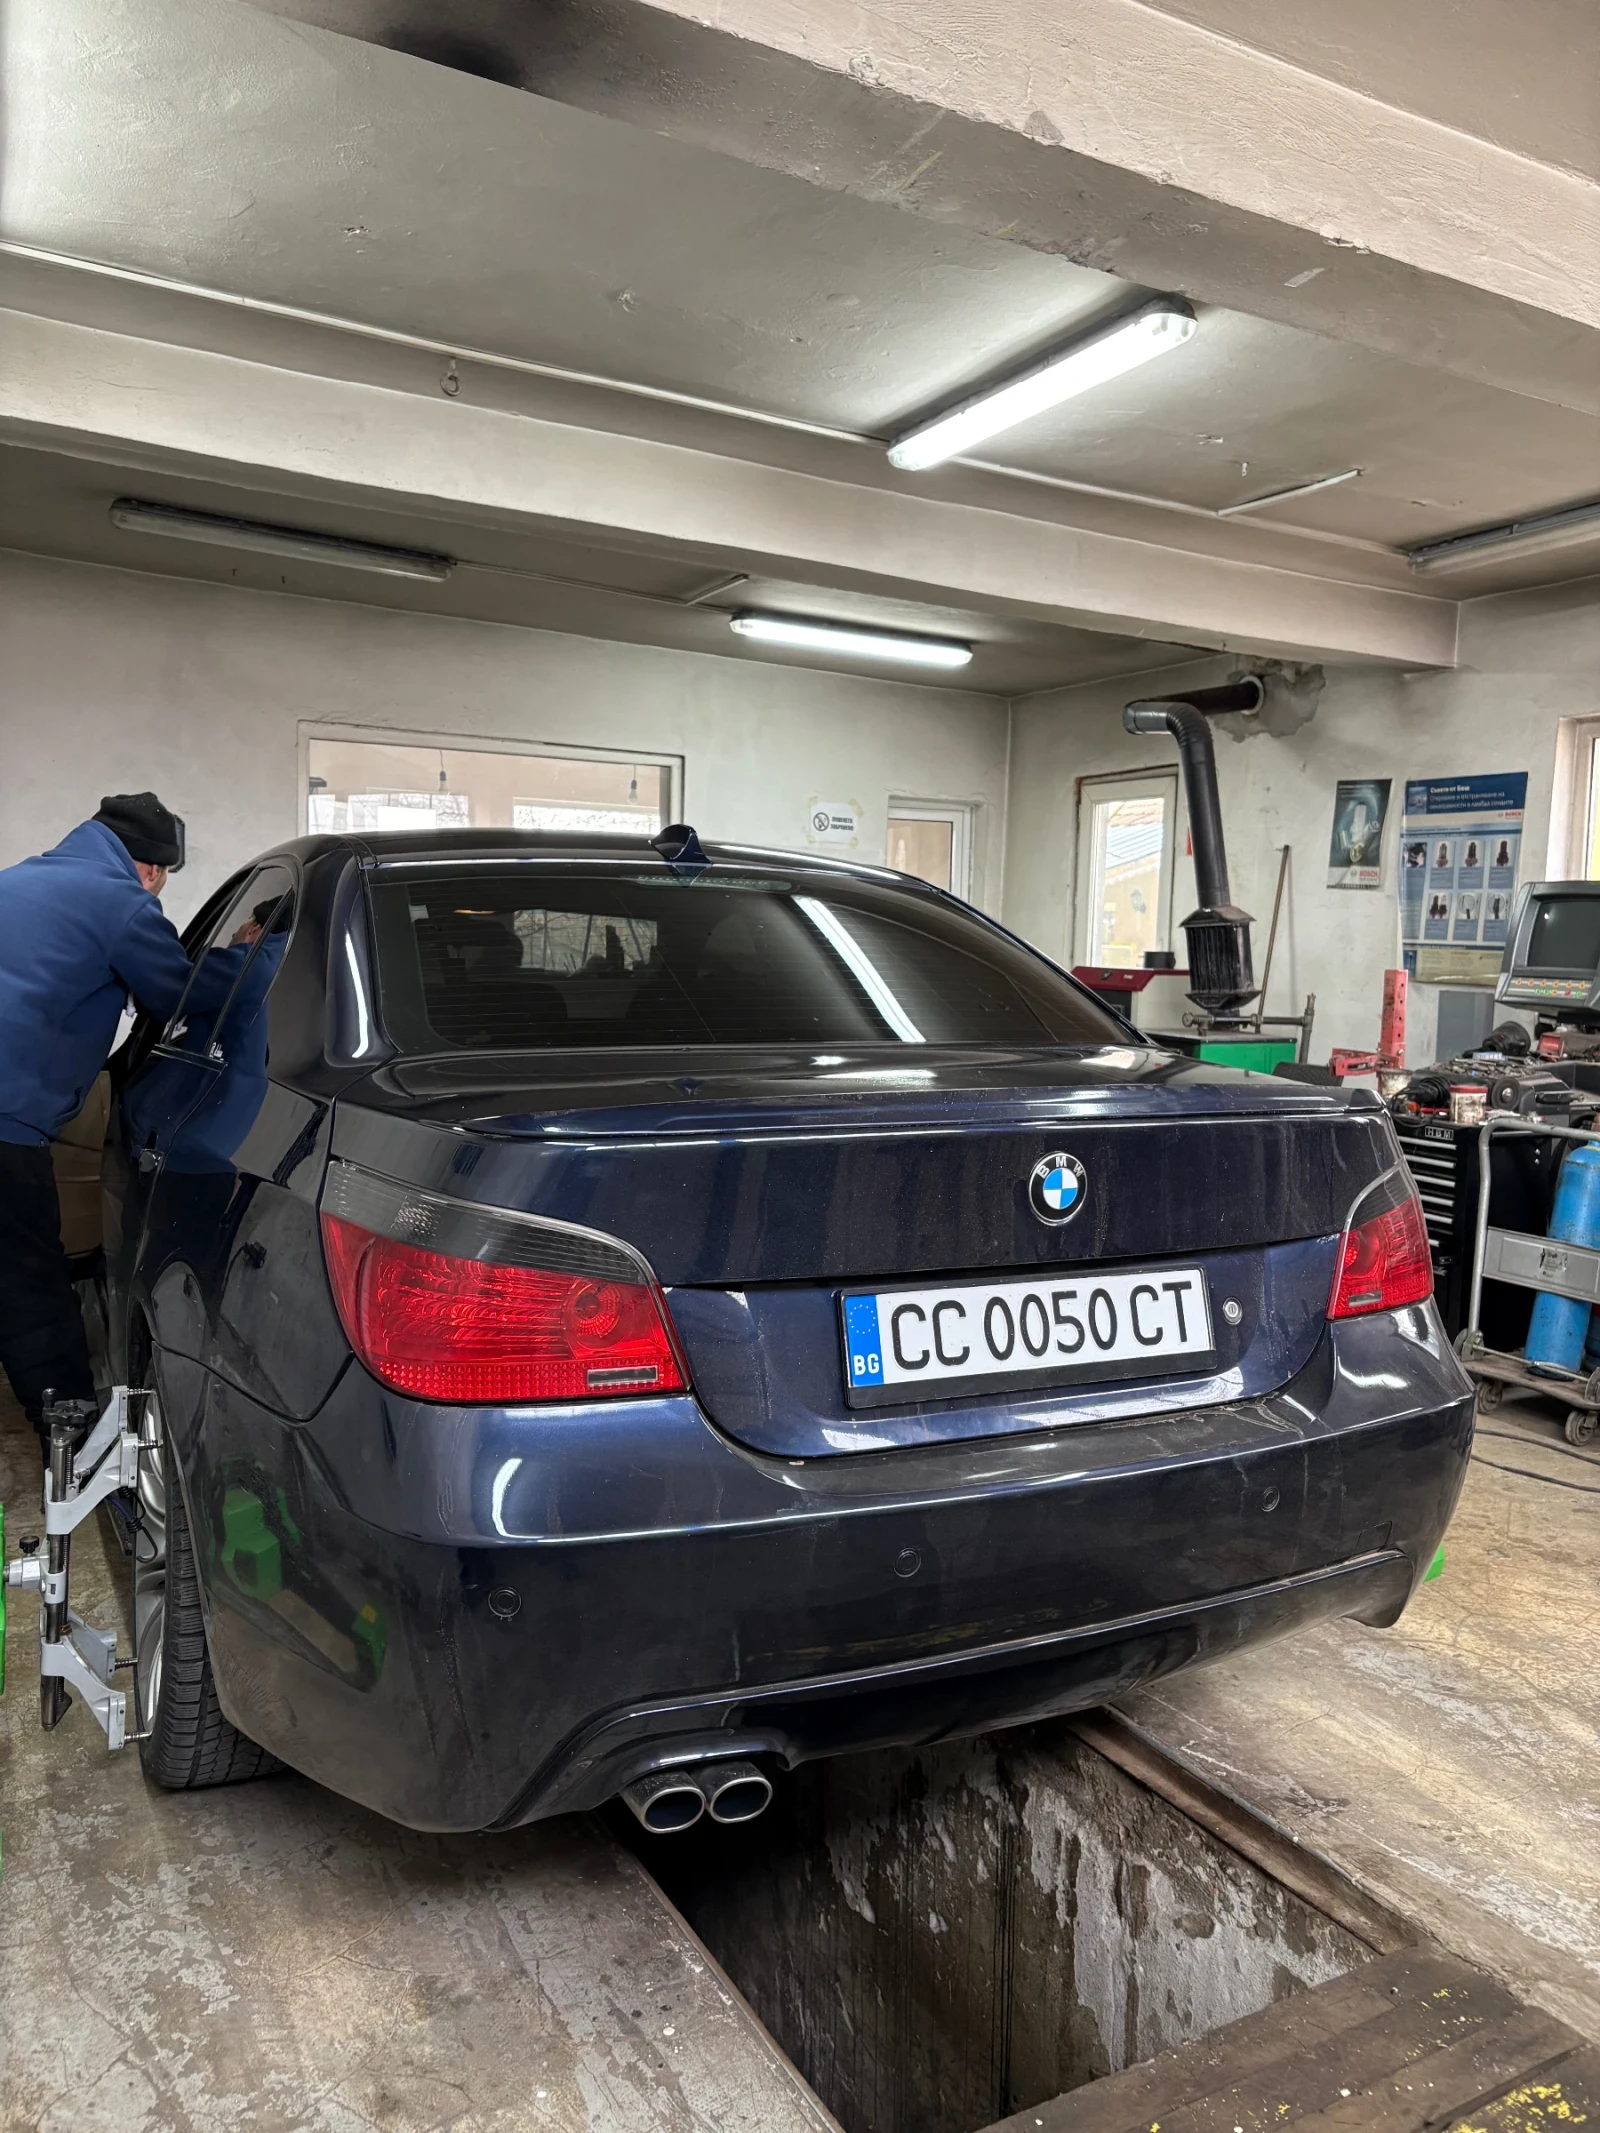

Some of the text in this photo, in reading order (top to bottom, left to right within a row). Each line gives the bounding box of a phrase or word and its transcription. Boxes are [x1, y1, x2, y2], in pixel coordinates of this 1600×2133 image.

[1036, 1155, 1085, 1180] BMW
[890, 1280, 1193, 1370] CC 0050 CT
[852, 1353, 880, 1376] BG
